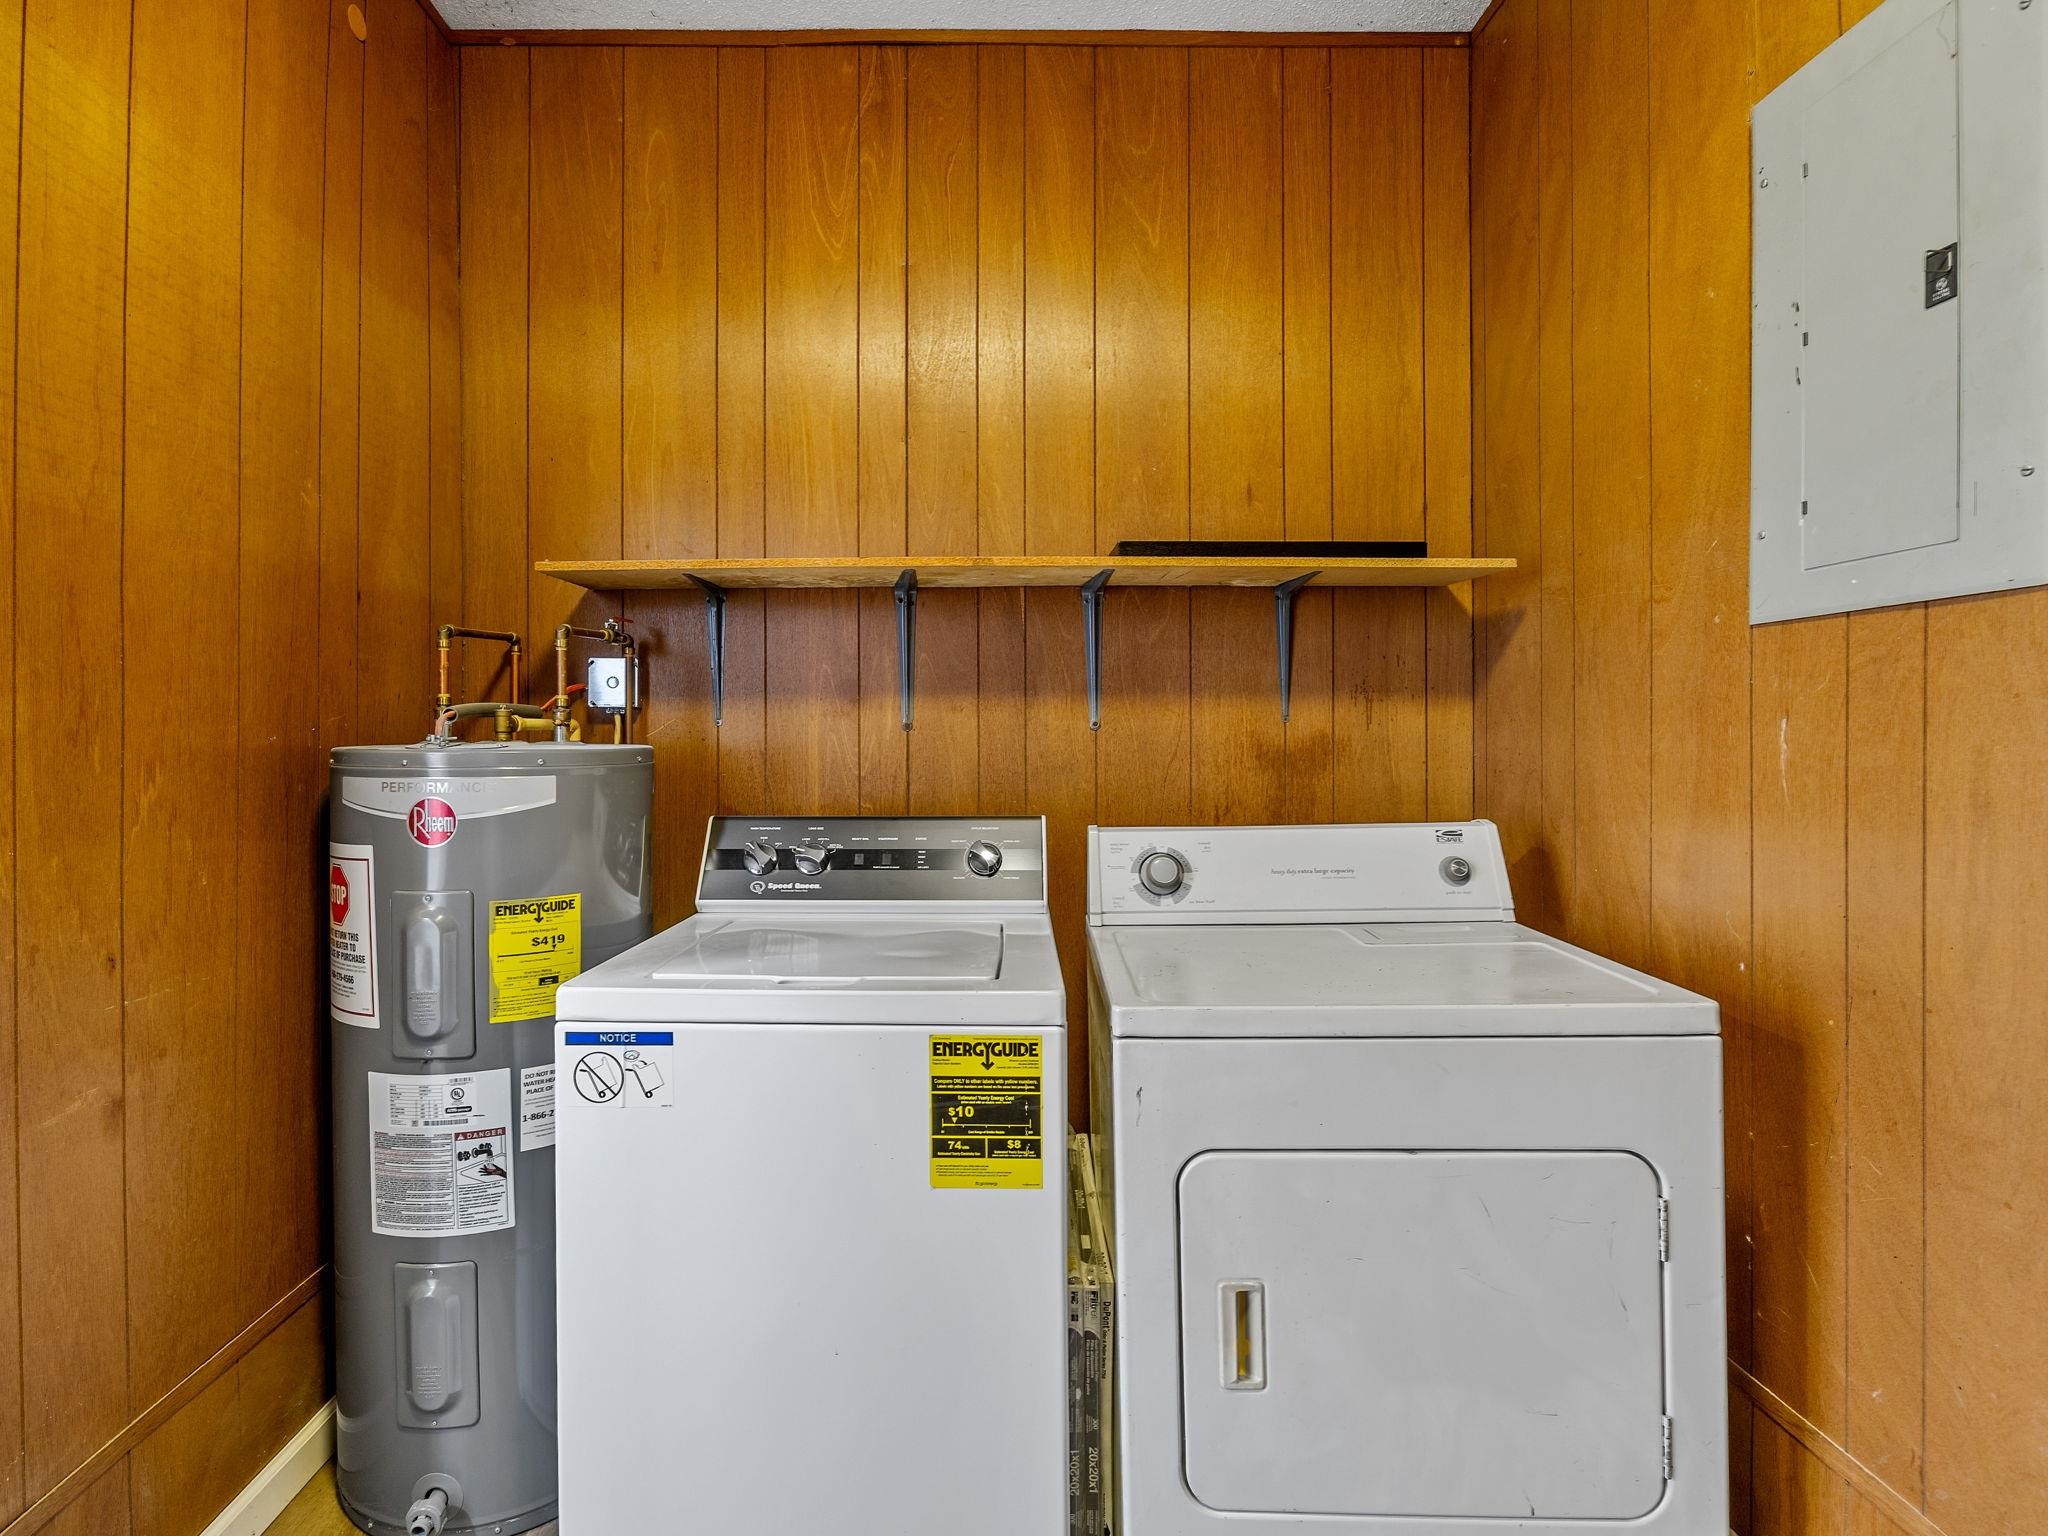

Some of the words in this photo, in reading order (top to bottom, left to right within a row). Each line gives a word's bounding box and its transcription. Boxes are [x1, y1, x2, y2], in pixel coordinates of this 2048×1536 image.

[414, 799, 454, 839] Rheem
[768, 883, 793, 894] Speed
[496, 899, 575, 918] ENERGYGUIDE
[532, 934, 565, 947] $419
[341, 952, 366, 964] PURCHASE
[599, 1034, 637, 1043] NOTICE
[932, 1042, 1039, 1061] ENERGYGUIDE
[523, 1078, 544, 1087] WATER
[526, 1086, 544, 1094] PLACE
[948, 1106, 974, 1118] $10
[466, 1129, 504, 1139] DANGER
[948, 1141, 962, 1150] 74
[1008, 1140, 1021, 1149] $8
[1103, 1301, 1111, 1329] DuPont
[1070, 1450, 1080, 1496] 20x20x1
[1089, 1447, 1098, 1494] 20x20x1
